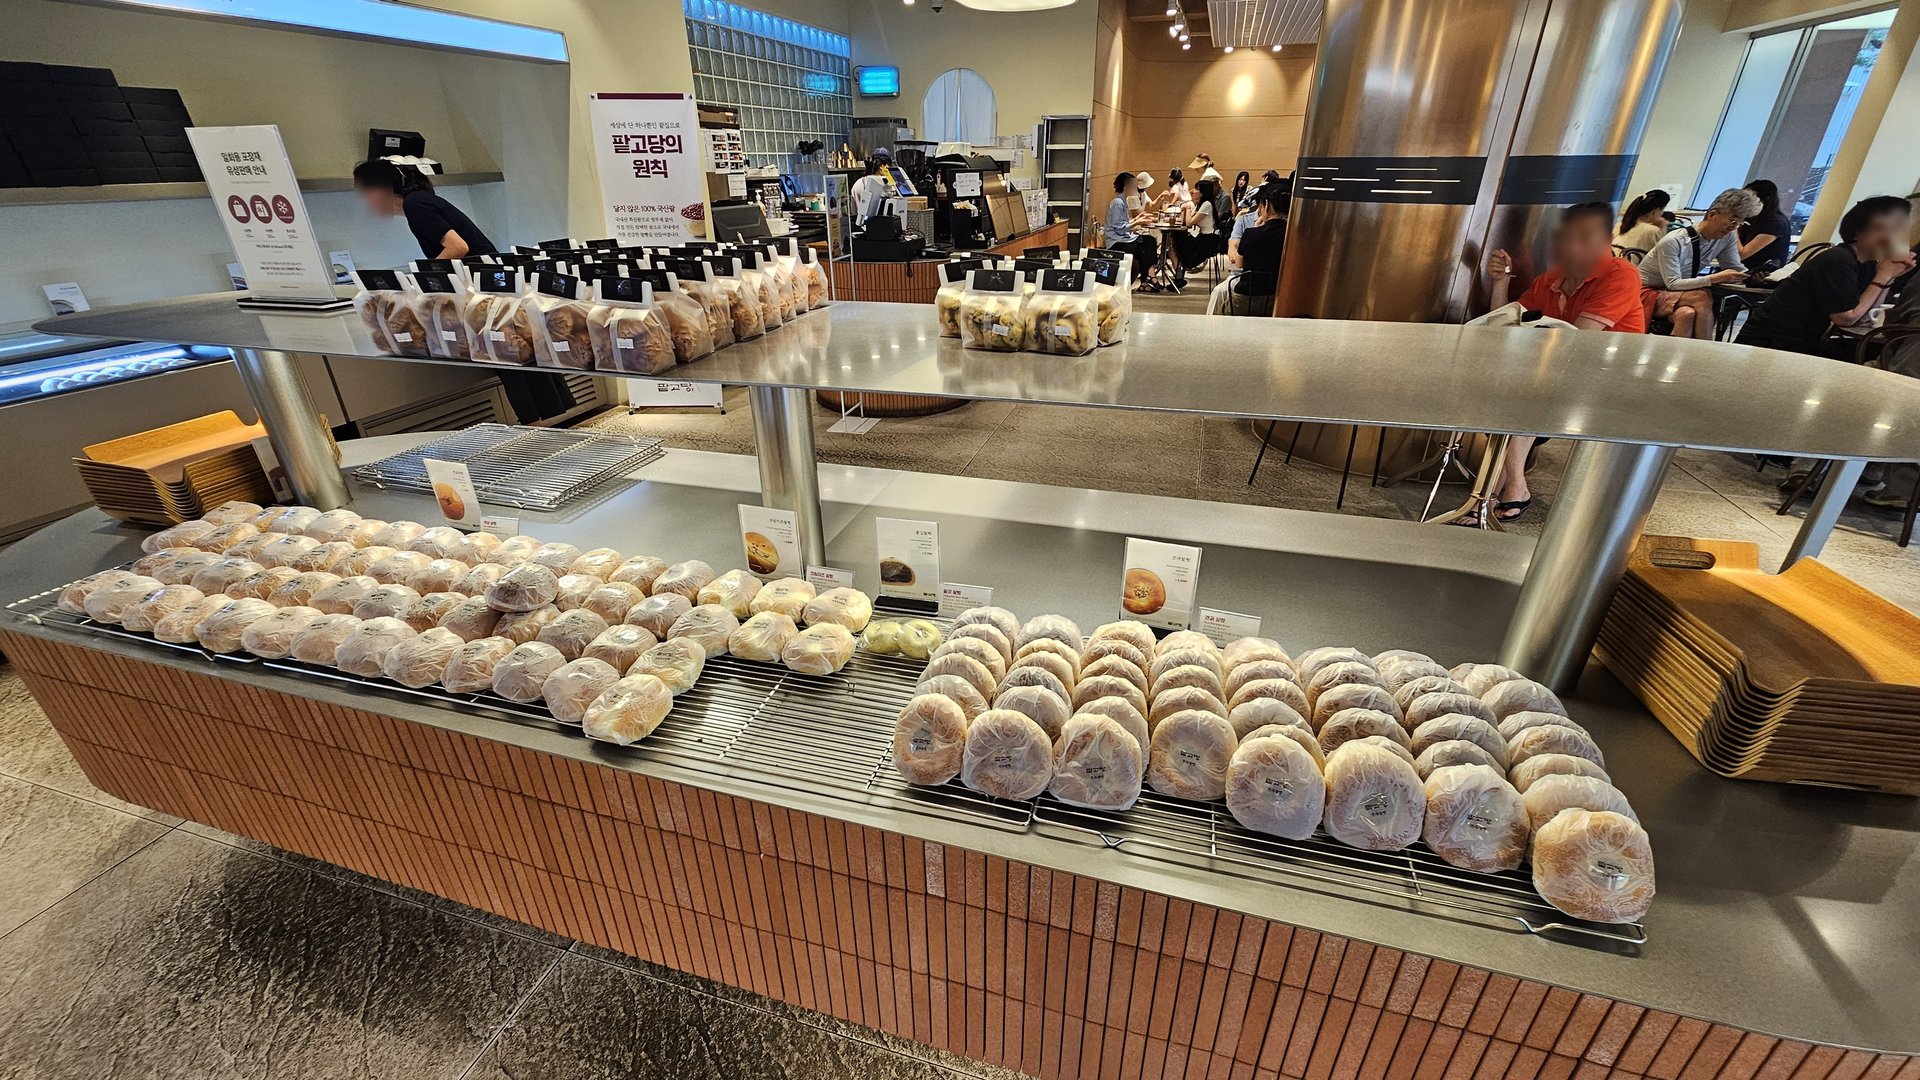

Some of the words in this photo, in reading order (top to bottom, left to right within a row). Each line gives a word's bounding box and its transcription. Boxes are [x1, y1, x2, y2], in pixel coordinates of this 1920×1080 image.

[611, 134, 683, 154] 팥고당의
[220, 151, 241, 162] 일회용
[226, 164, 253, 176] 유상판매
[252, 164, 268, 176] 안내
[632, 158, 669, 179] 원칙
[640, 205, 656, 213] 100%
[657, 383, 694, 392] 팥고당
